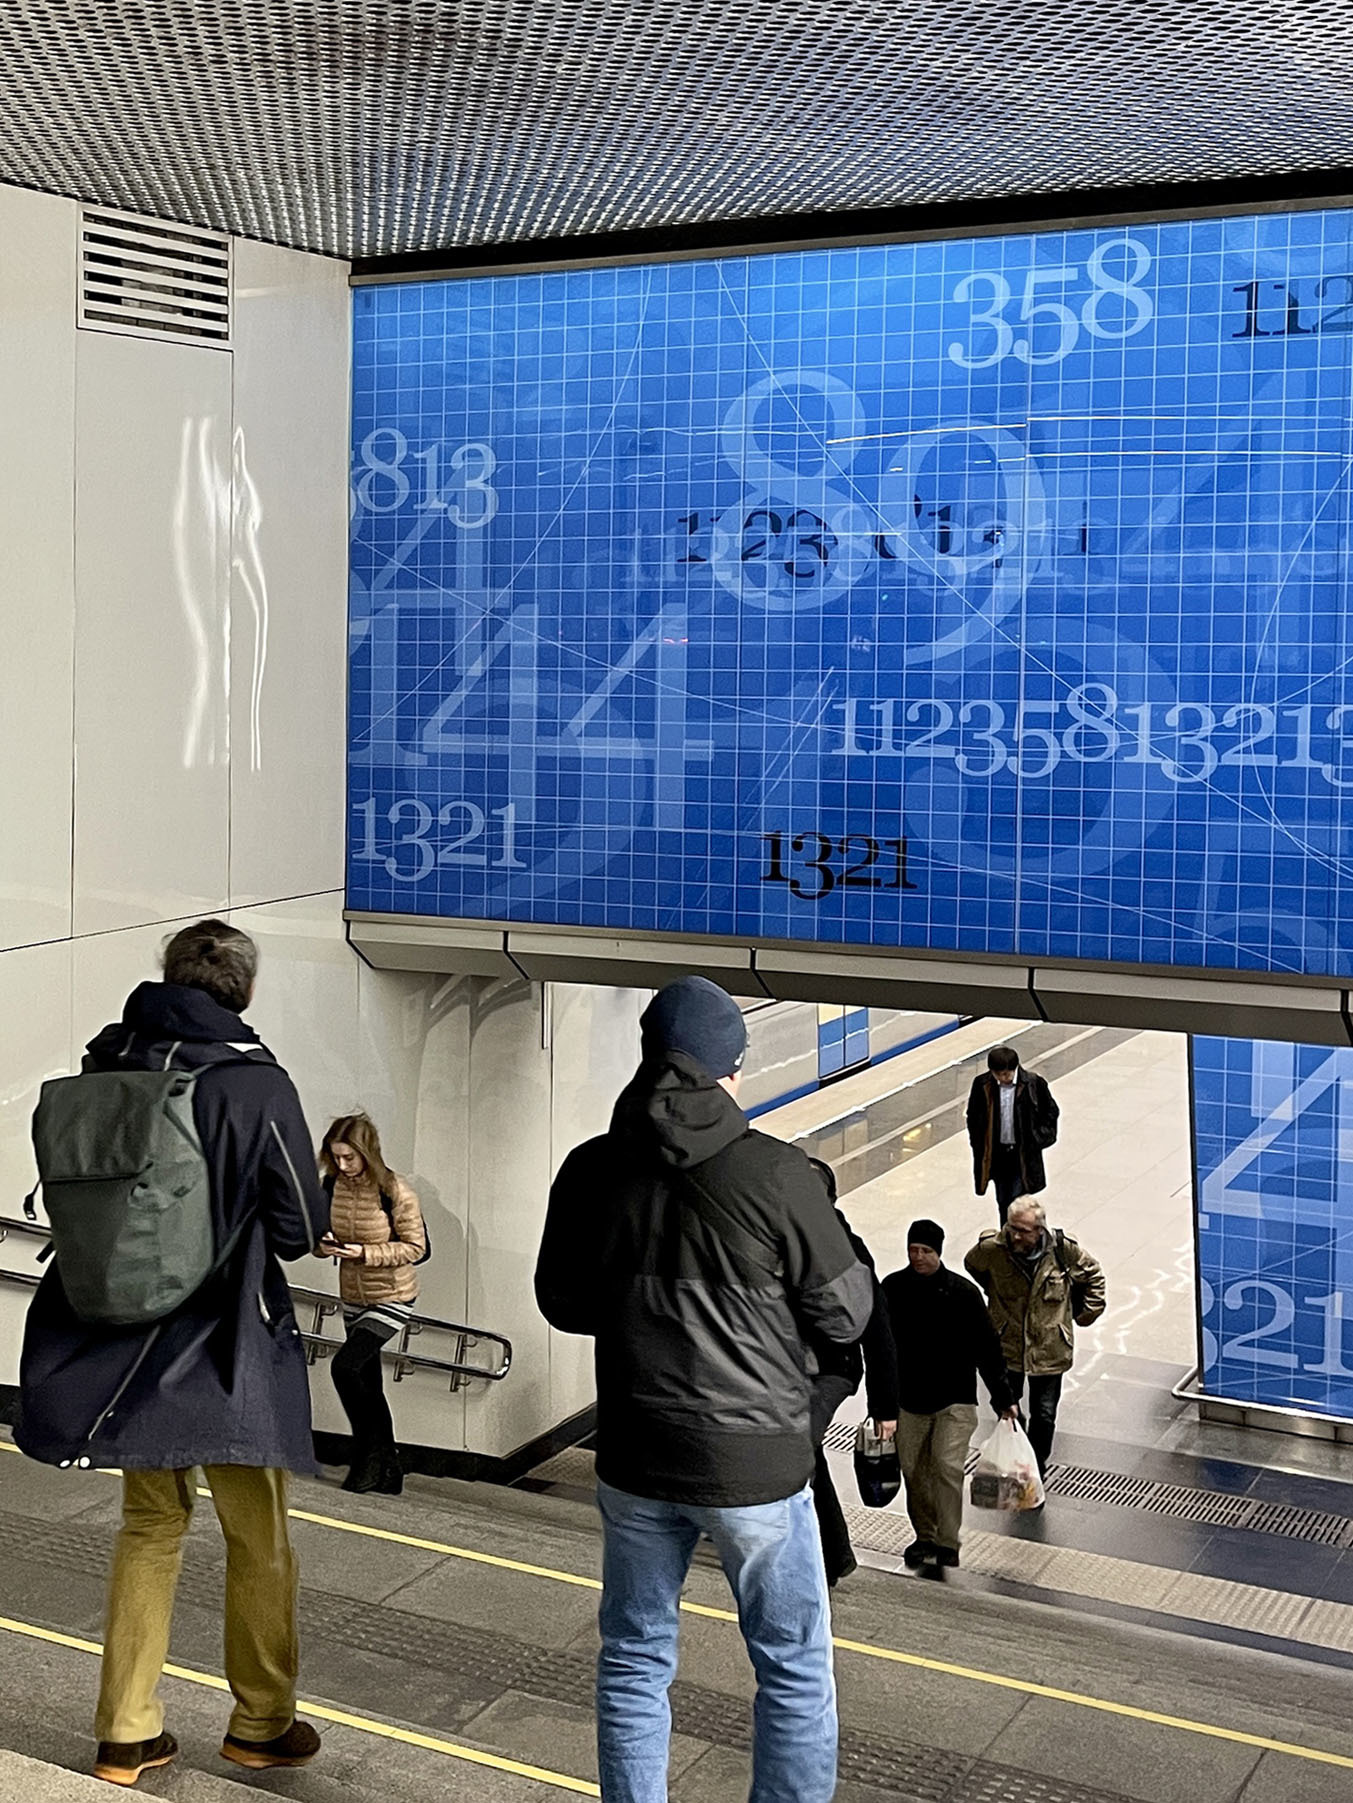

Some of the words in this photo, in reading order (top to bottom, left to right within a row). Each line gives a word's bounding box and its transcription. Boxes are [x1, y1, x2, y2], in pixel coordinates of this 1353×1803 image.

[949, 238, 1154, 369] 358
[352, 797, 527, 882] 1321
[760, 831, 918, 900] 1321
